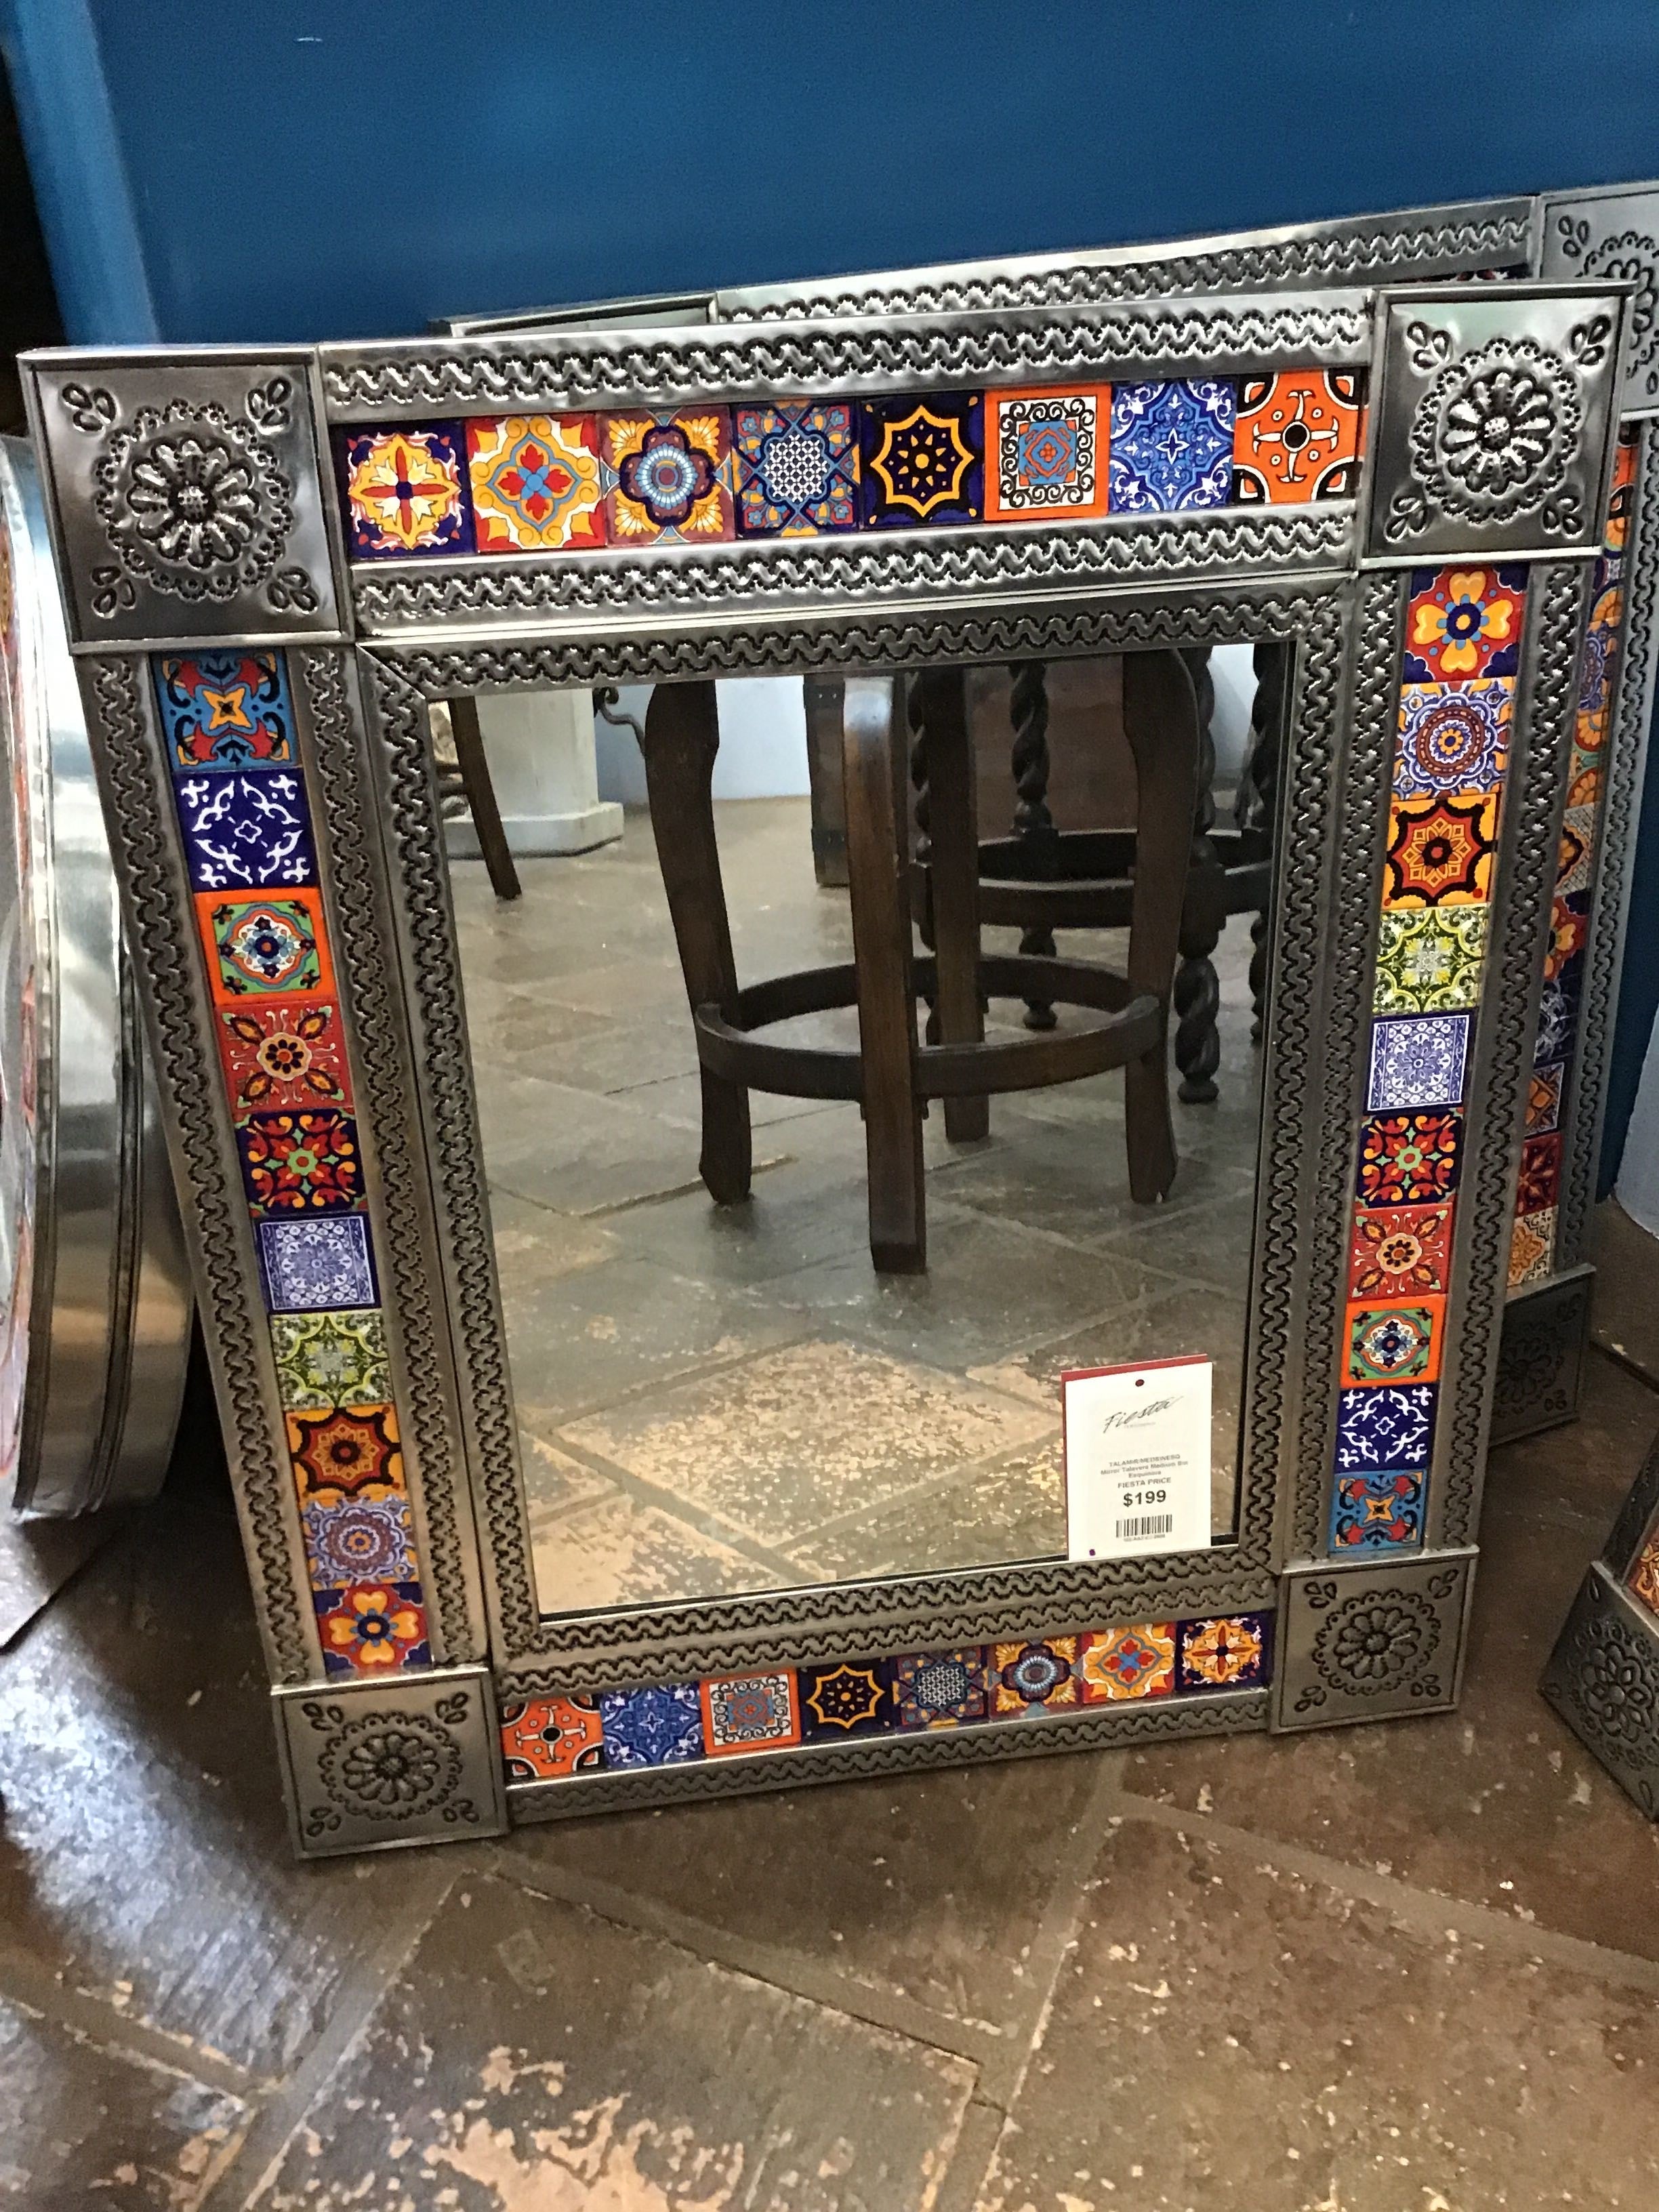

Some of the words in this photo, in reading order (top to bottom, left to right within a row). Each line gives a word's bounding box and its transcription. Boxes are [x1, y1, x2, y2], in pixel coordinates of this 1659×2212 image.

[1103, 1395, 1184, 1434] Fiesta
[1118, 1479, 1145, 1488] FIESTA
[1147, 1477, 1171, 1486] PRICE
[1123, 1490, 1166, 1507] $199
